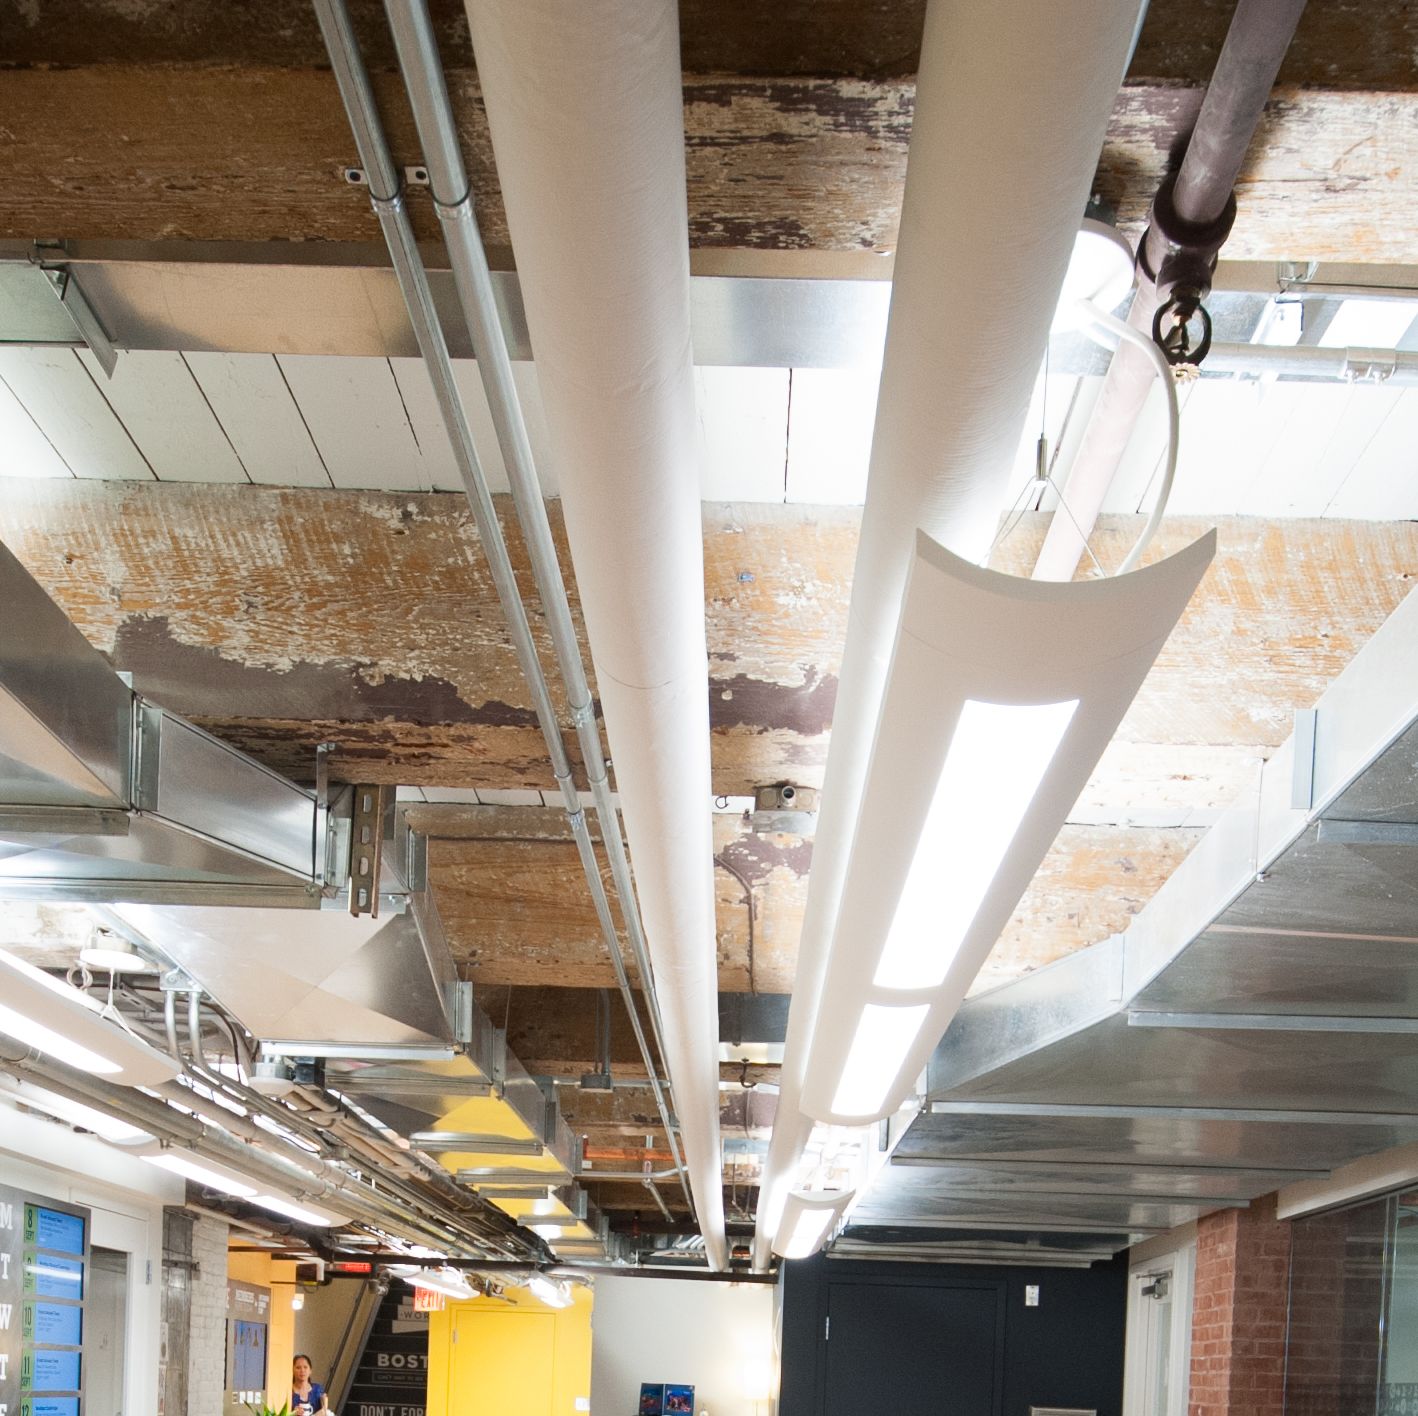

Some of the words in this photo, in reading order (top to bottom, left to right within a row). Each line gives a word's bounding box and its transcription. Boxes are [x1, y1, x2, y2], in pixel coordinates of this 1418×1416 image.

[0, 1202, 13, 1230] M
[27, 1209, 33, 1229] 8
[0, 1253, 11, 1280] T
[25, 1306, 32, 1325] 10
[23, 1355, 30, 1375] 11
